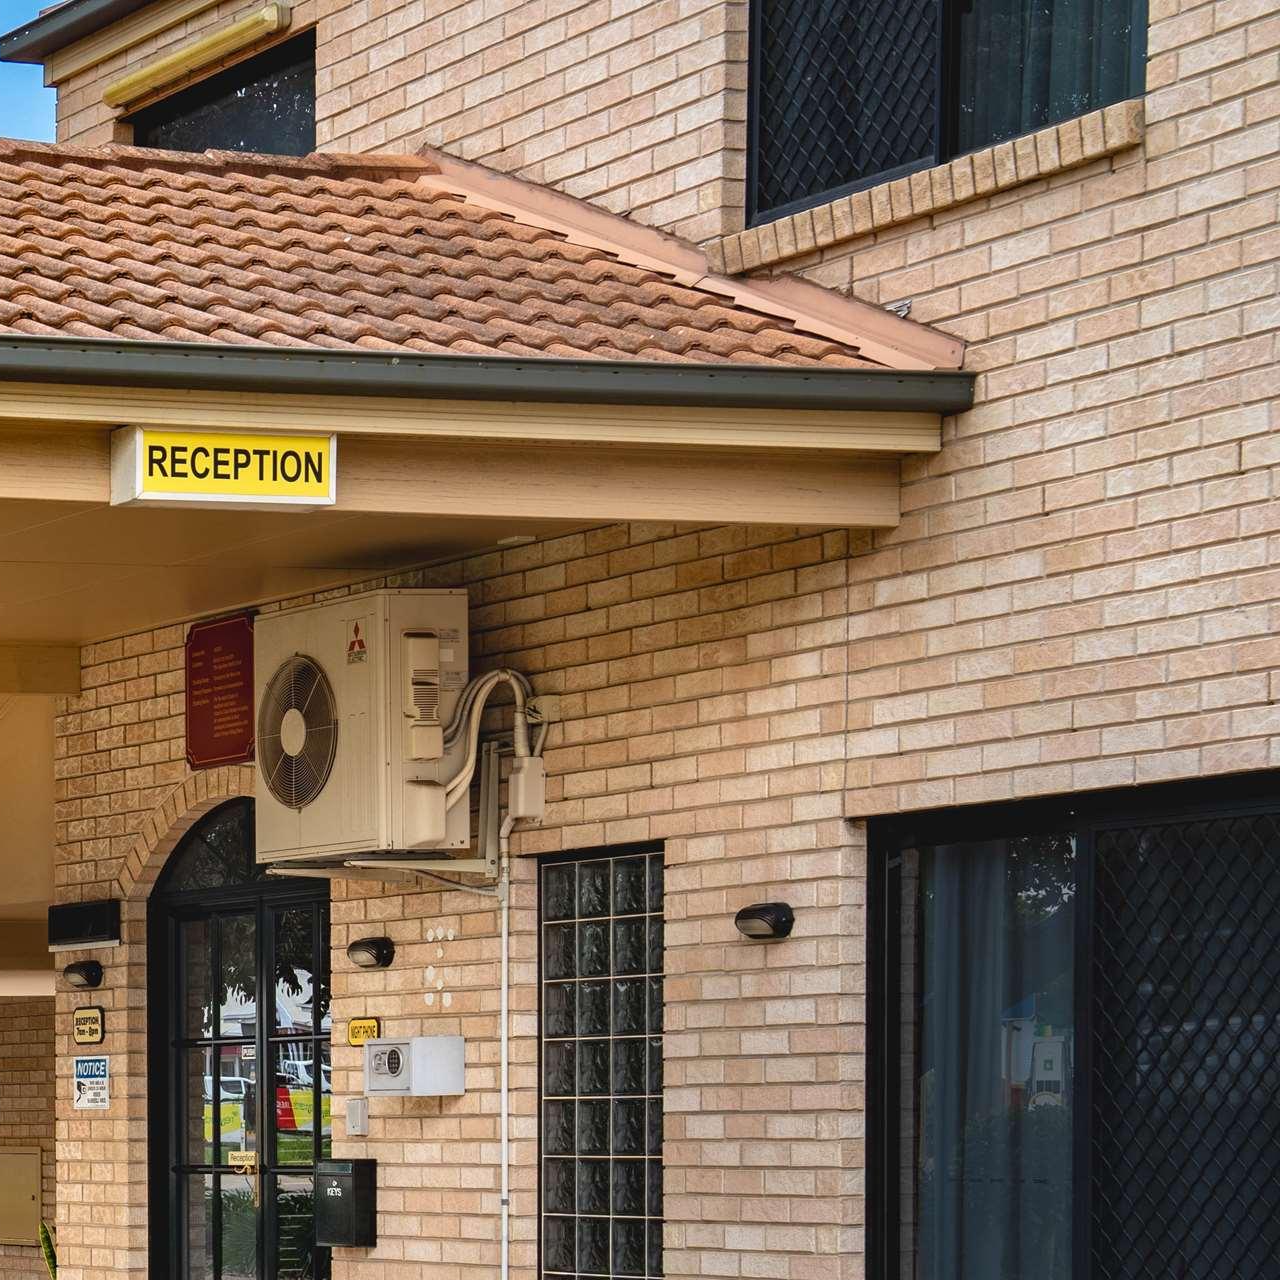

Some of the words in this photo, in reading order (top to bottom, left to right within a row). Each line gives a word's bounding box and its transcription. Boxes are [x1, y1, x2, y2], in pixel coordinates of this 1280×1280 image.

[148, 445, 323, 483] RECEPTION
[75, 1016, 99, 1026] RECEPTION
[77, 1062, 106, 1076] NOTICE
[327, 1187, 342, 1197] KEYS
